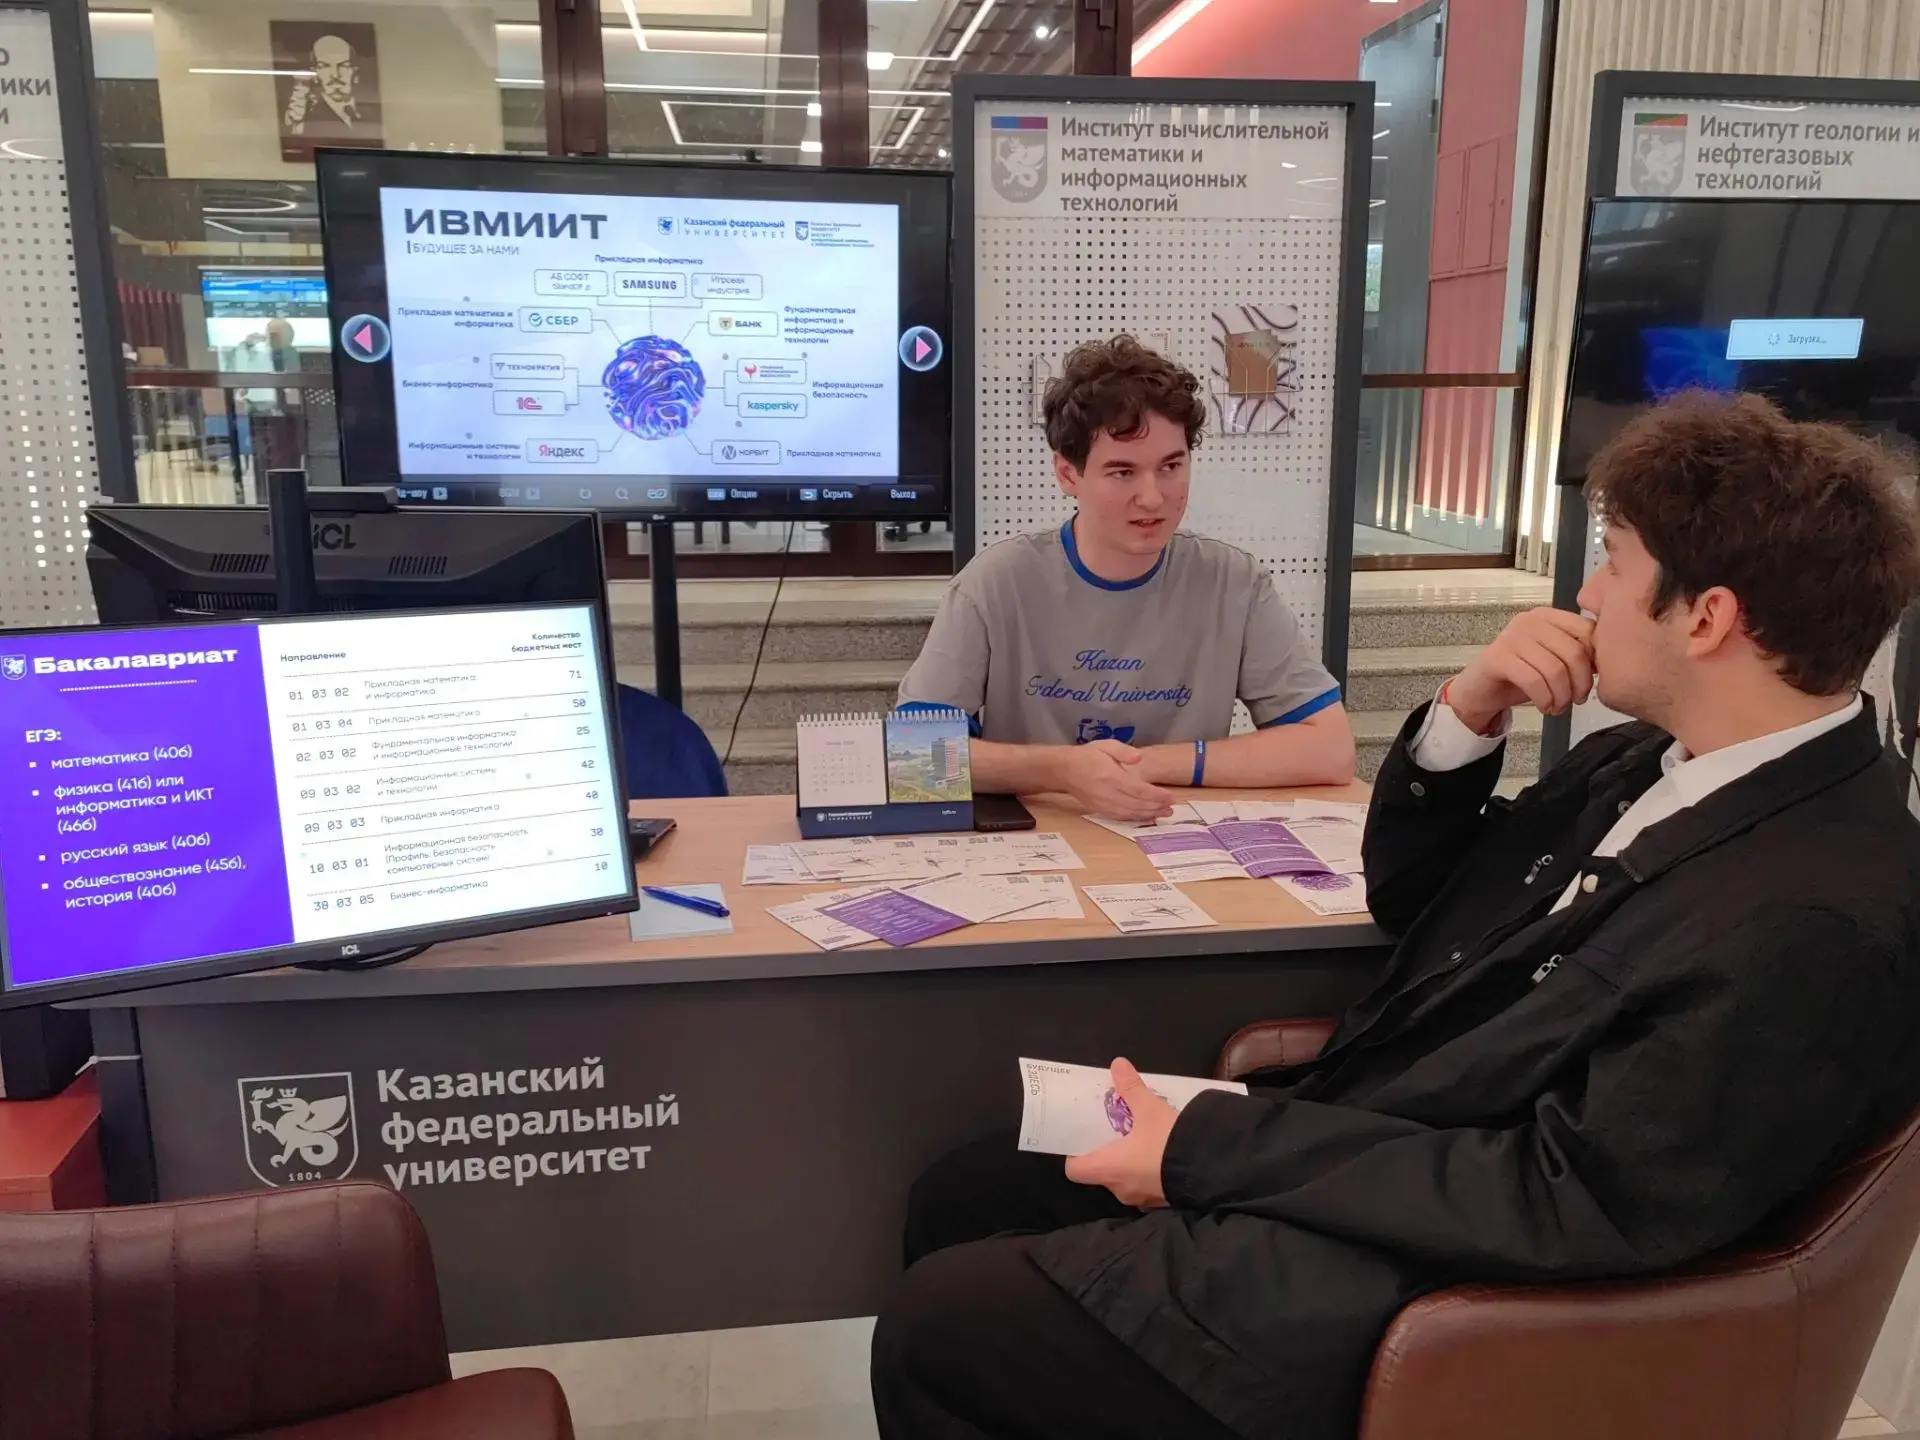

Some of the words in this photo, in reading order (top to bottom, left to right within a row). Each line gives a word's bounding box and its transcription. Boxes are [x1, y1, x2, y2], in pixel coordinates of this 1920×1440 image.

[1061, 116, 1154, 141] Институт
[1160, 121, 1329, 140] вычислительной
[1700, 115, 1799, 143] Институт
[1804, 122, 1900, 142] геологии
[1908, 127, 1919, 143] и
[1060, 145, 1184, 163] математики
[1191, 150, 1203, 162] и
[1697, 142, 1854, 168] нефтегазовых
[1060, 168, 1247, 192] информационных
[1696, 171, 1821, 190] технологий
[1060, 195, 1178, 213] технологий
[404, 208, 608, 239] ИВМИИТ
[684, 217, 727, 227] Казанский
[729, 220, 785, 229] федеральный
[413, 242, 467, 254] БУДУЩЕЕ
[469, 244, 483, 254] ЗА
[486, 245, 520, 255] НАМИ
[595, 254, 646, 263] Прикладная
[648, 256, 703, 265] информатика
[622, 279, 677, 290] SAMSUNG
[398, 308, 452, 318] Прикладная
[455, 310, 506, 318] математика
[784, 306, 856, 315] Фундаментальная
[454, 320, 514, 329] информатика
[546, 315, 579, 326] СБЕР
[735, 320, 762, 328] БАНК
[784, 316, 836, 325] информатика
[784, 326, 854, 335] информационные
[784, 336, 829, 345] технологии
[402, 380, 494, 389] Бизнес-информатика
[812, 381, 884, 390] Информационная
[812, 391, 868, 400] безопасность
[747, 400, 799, 412] kaspersky
[408, 442, 484, 451] Информационные
[485, 443, 521, 451] системы
[538, 444, 585, 458] Яндекс
[474, 453, 521, 461] технологии
[787, 449, 834, 459] Прикладная
[835, 450, 881, 458] математика
[730, 489, 758, 500] Опции
[822, 489, 854, 500] Скрыть
[890, 489, 917, 500] Выход
[532, 632, 581, 642] Количество
[511, 643, 561, 654] бюджетных
[562, 641, 582, 651] мест
[33, 648, 238, 675] Бакалавриат
[280, 651, 346, 663] Направление
[1072, 649, 1146, 671] Kazan
[568, 670, 582, 680] 71
[364, 679, 420, 689] Прикладная
[423, 675, 477, 685] математика
[374, 688, 436, 700] информатика
[1098, 680, 1193, 708] University
[573, 698, 587, 708] 50
[368, 714, 426, 725] Прикладная
[427, 710, 481, 720] математика
[25, 728, 62, 744] ЕГЭ:
[576, 726, 590, 736] 25
[371, 736, 455, 750] Фундаментальная
[456, 729, 517, 742] информатика
[380, 746, 462, 760] информационные
[463, 741, 513, 751] технологии
[51, 750, 150, 770] математика
[581, 759, 595, 769] 42
[376, 771, 458, 785] Информационные
[54, 782, 114, 800] физика
[155, 775, 184, 789] или
[386, 784, 438, 796] технологии
[56, 795, 167, 816] информатика
[171, 793, 181, 804] и
[185, 787, 215, 802] ИКТ
[586, 790, 599, 800] 40
[380, 811, 438, 825] Прикладная
[439, 803, 500, 817] информатика
[590, 827, 604, 837] 30
[384, 836, 466, 852] Информационная
[468, 828, 529, 842] безопасность
[61, 843, 129, 865] русский
[132, 839, 169, 855] язык
[433, 844, 496, 858] Безопасность
[387, 859, 454, 875] компьютерных
[594, 861, 609, 871] 10
[63, 863, 202, 892] обществознание
[389, 879, 489, 901] Бизнес-информатика
[66, 888, 133, 910] история
[377, 1056, 605, 1102] Казанский
[380, 1093, 680, 1153] федеральный
[383, 1145, 651, 1191] университет
[288, 1171, 322, 1183] 1804
